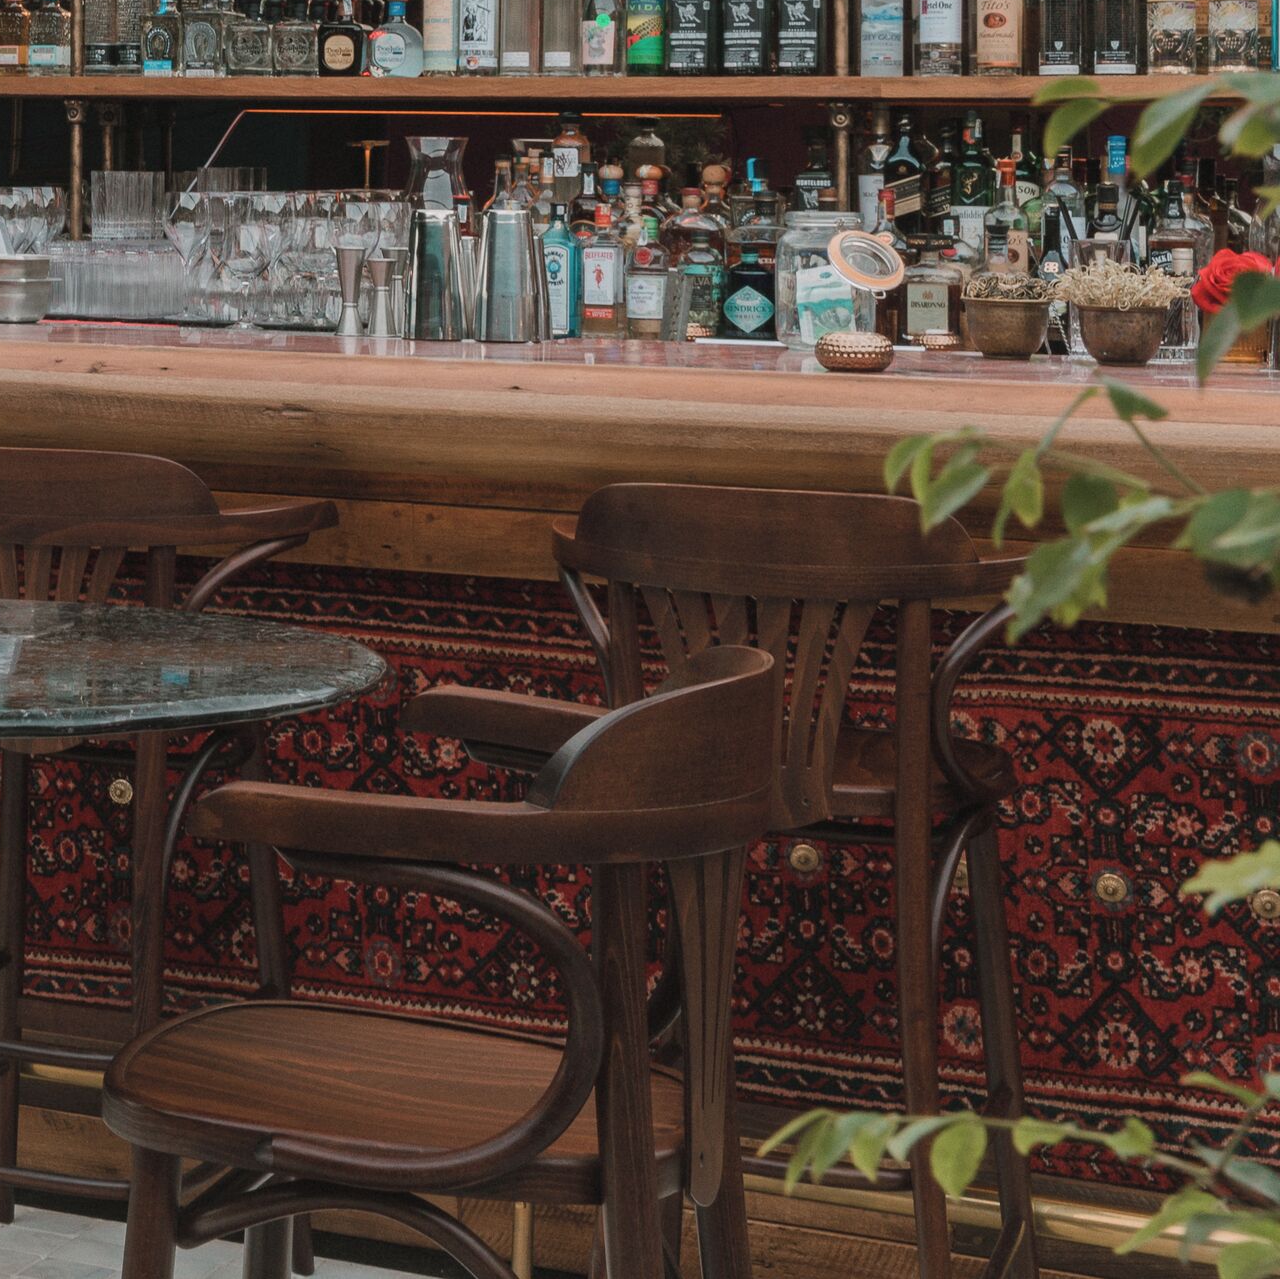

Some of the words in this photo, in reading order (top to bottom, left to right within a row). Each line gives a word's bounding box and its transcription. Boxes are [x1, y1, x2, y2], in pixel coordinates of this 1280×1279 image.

[938, 1, 953, 10] One
[980, 0, 1011, 11] Tito's
[978, 31, 1014, 39] Handmade
[795, 179, 831, 188] MONTELOBOS
[1017, 185, 1037, 197] SON
[584, 251, 614, 260] BEEFEATER
[910, 301, 946, 309] DISARONNO
